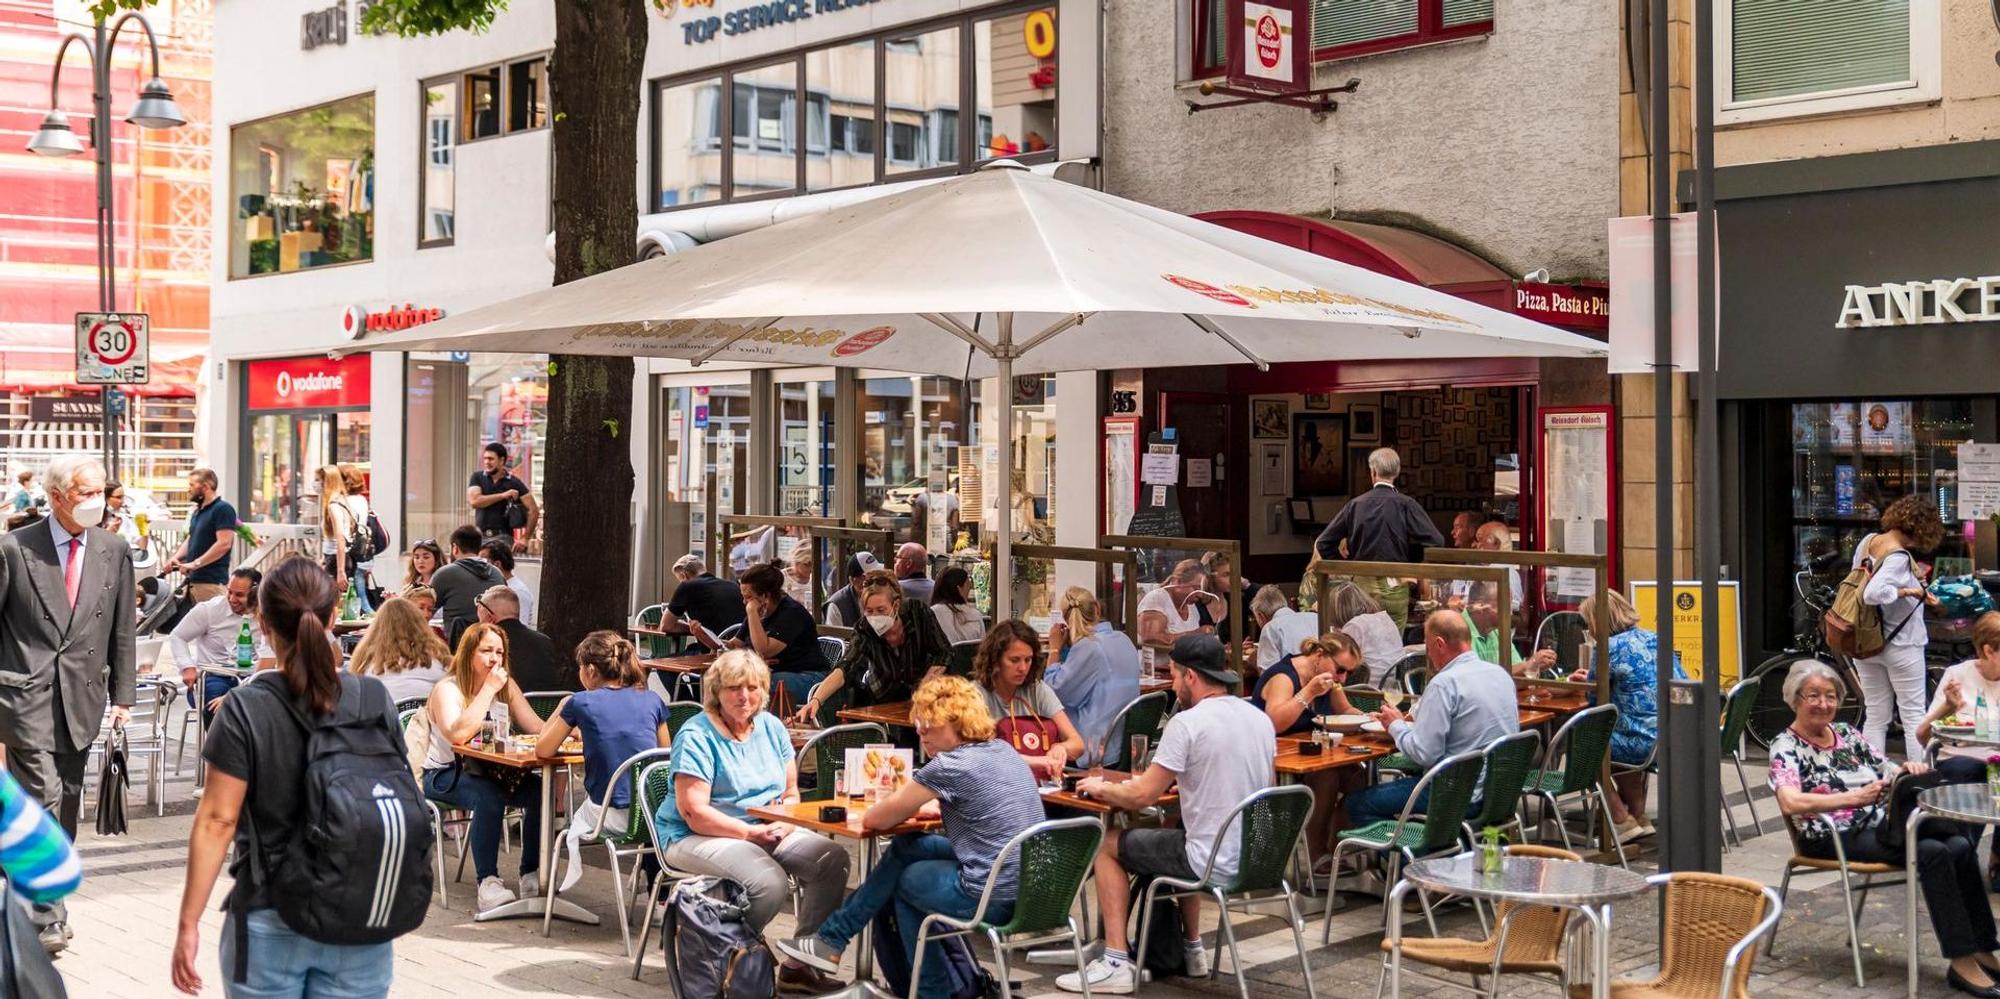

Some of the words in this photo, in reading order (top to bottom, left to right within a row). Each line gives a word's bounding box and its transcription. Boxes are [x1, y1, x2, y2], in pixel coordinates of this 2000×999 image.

[681, 16, 721, 45] TOP
[724, 0, 812, 36] SERVICE
[1517, 289, 1549, 312] Pizza,
[1552, 292, 1581, 314] Pasta
[1583, 300, 1590, 314] e
[366, 303, 442, 331] vodafone
[99, 331, 127, 352] 30
[292, 371, 343, 391] vodafone
